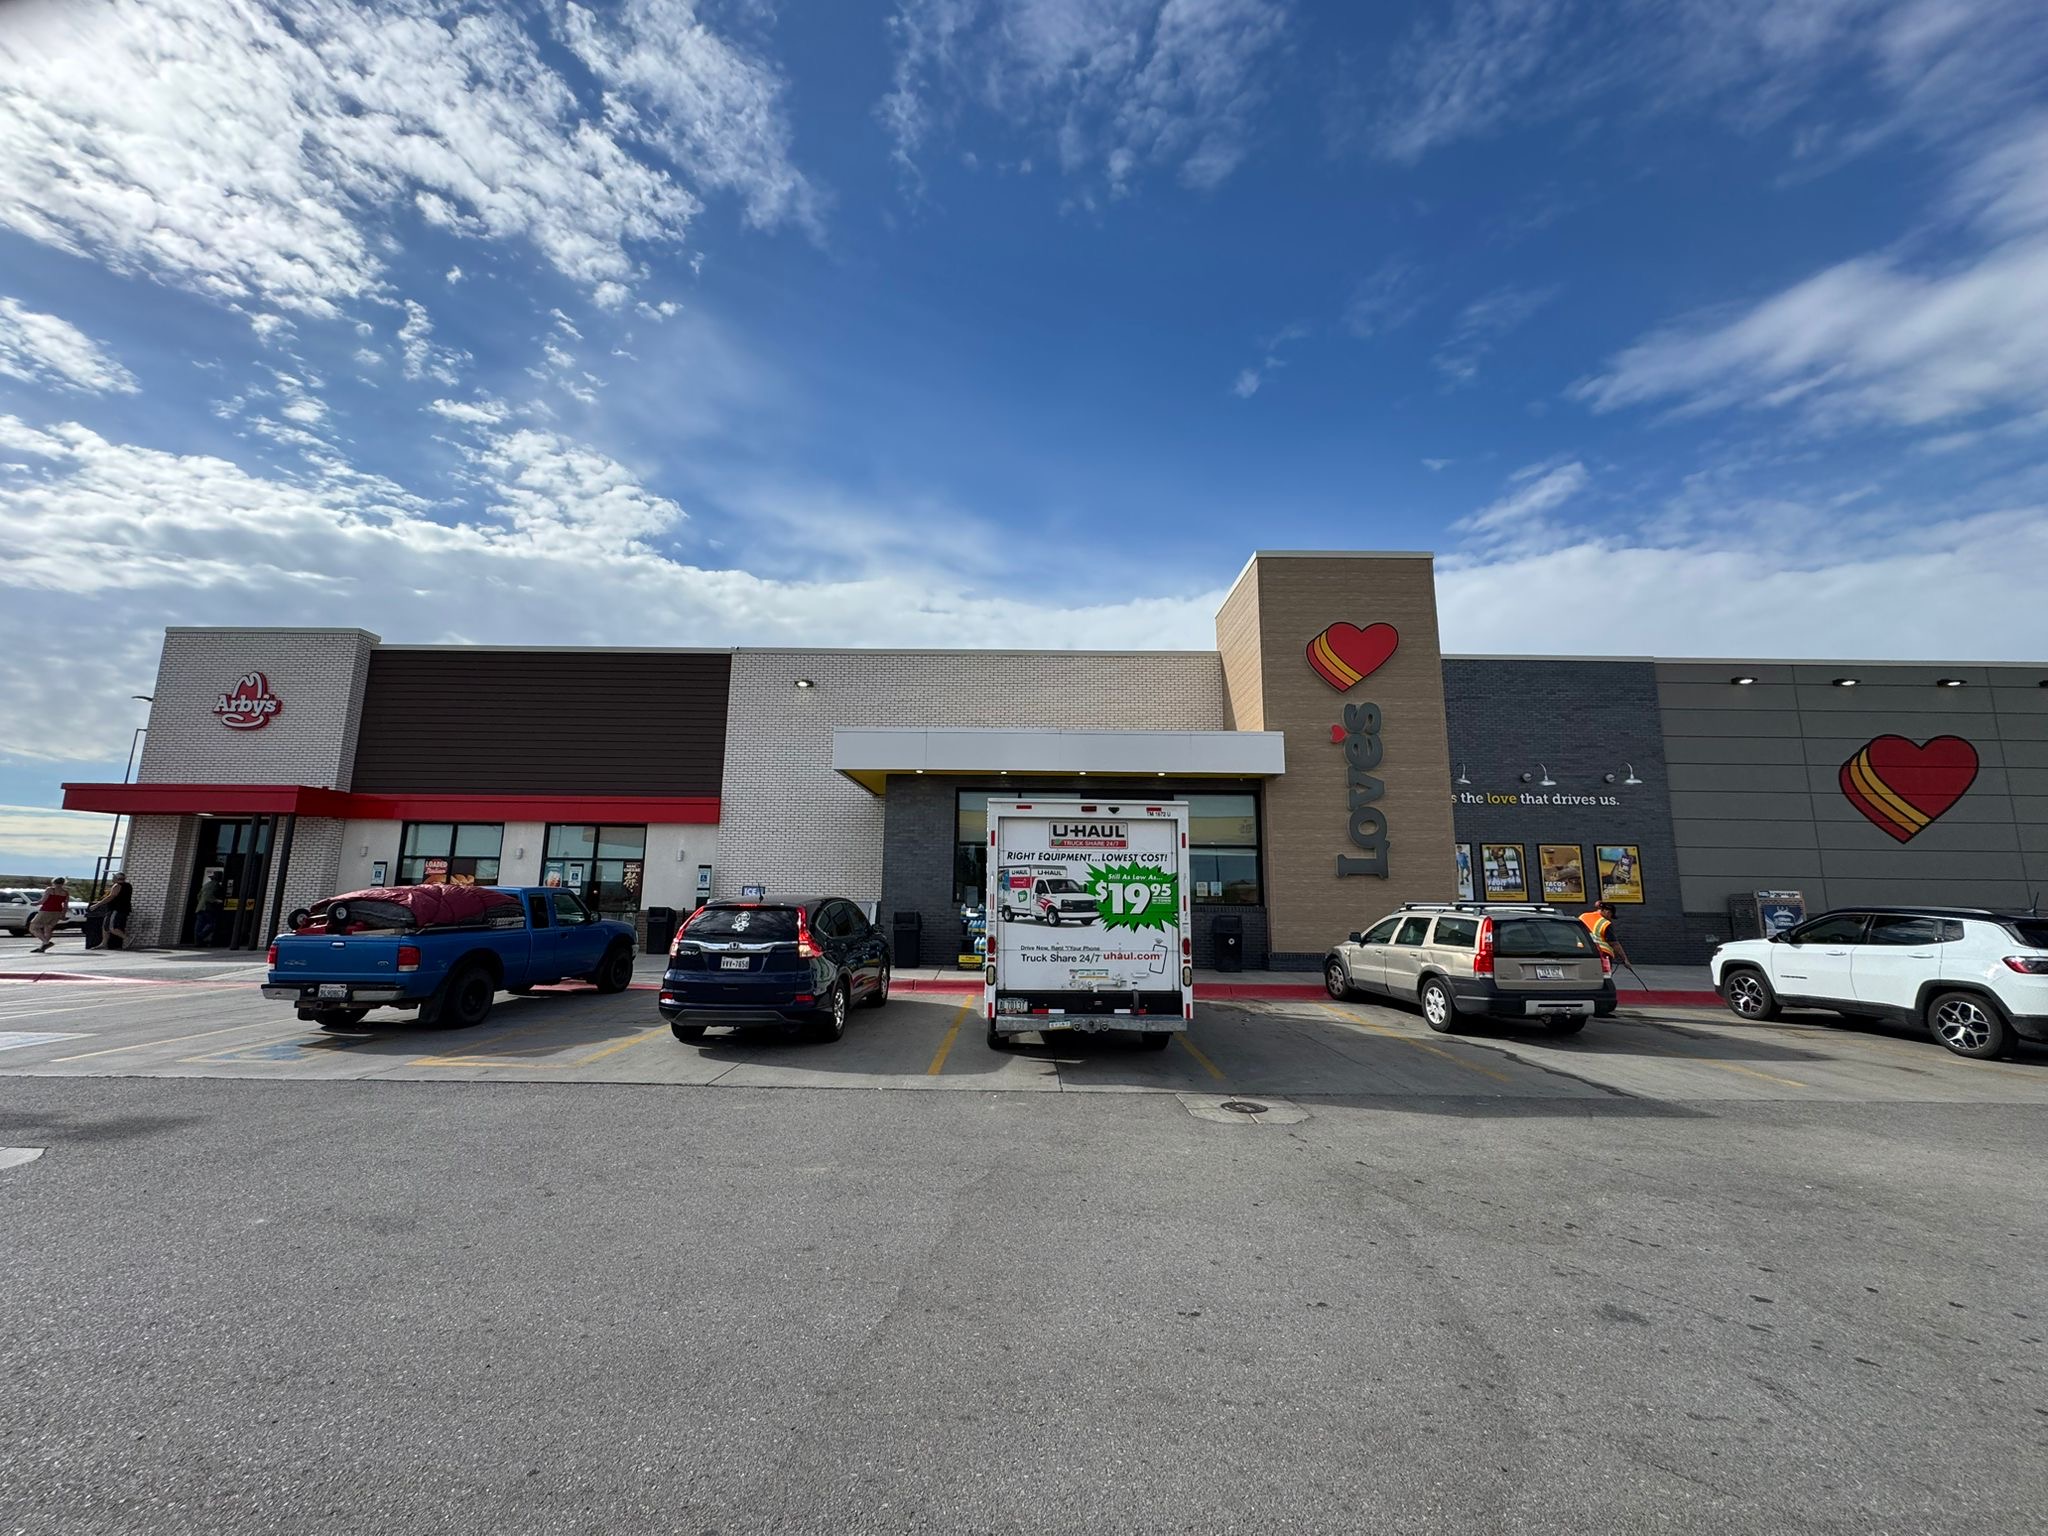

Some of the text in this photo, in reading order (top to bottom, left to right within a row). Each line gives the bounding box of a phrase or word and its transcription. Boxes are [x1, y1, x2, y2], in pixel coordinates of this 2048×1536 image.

[213, 694, 277, 717] Arby's
[1330, 701, 1391, 880] Love's
[1461, 792, 1484, 804] the
[1487, 793, 1517, 804] love
[1520, 793, 1549, 805] that
[1552, 794, 1596, 805] drives
[1599, 796, 1620, 806] us.
[1052, 825, 1125, 838] U-HAUL
[1006, 852, 1036, 861] RIGHT
[1141, 853, 1168, 862] COST!
[744, 888, 758, 896] ICE
[1021, 953, 1100, 964] Truck Share 24/7
[1103, 952, 1160, 961] uhaul.com
